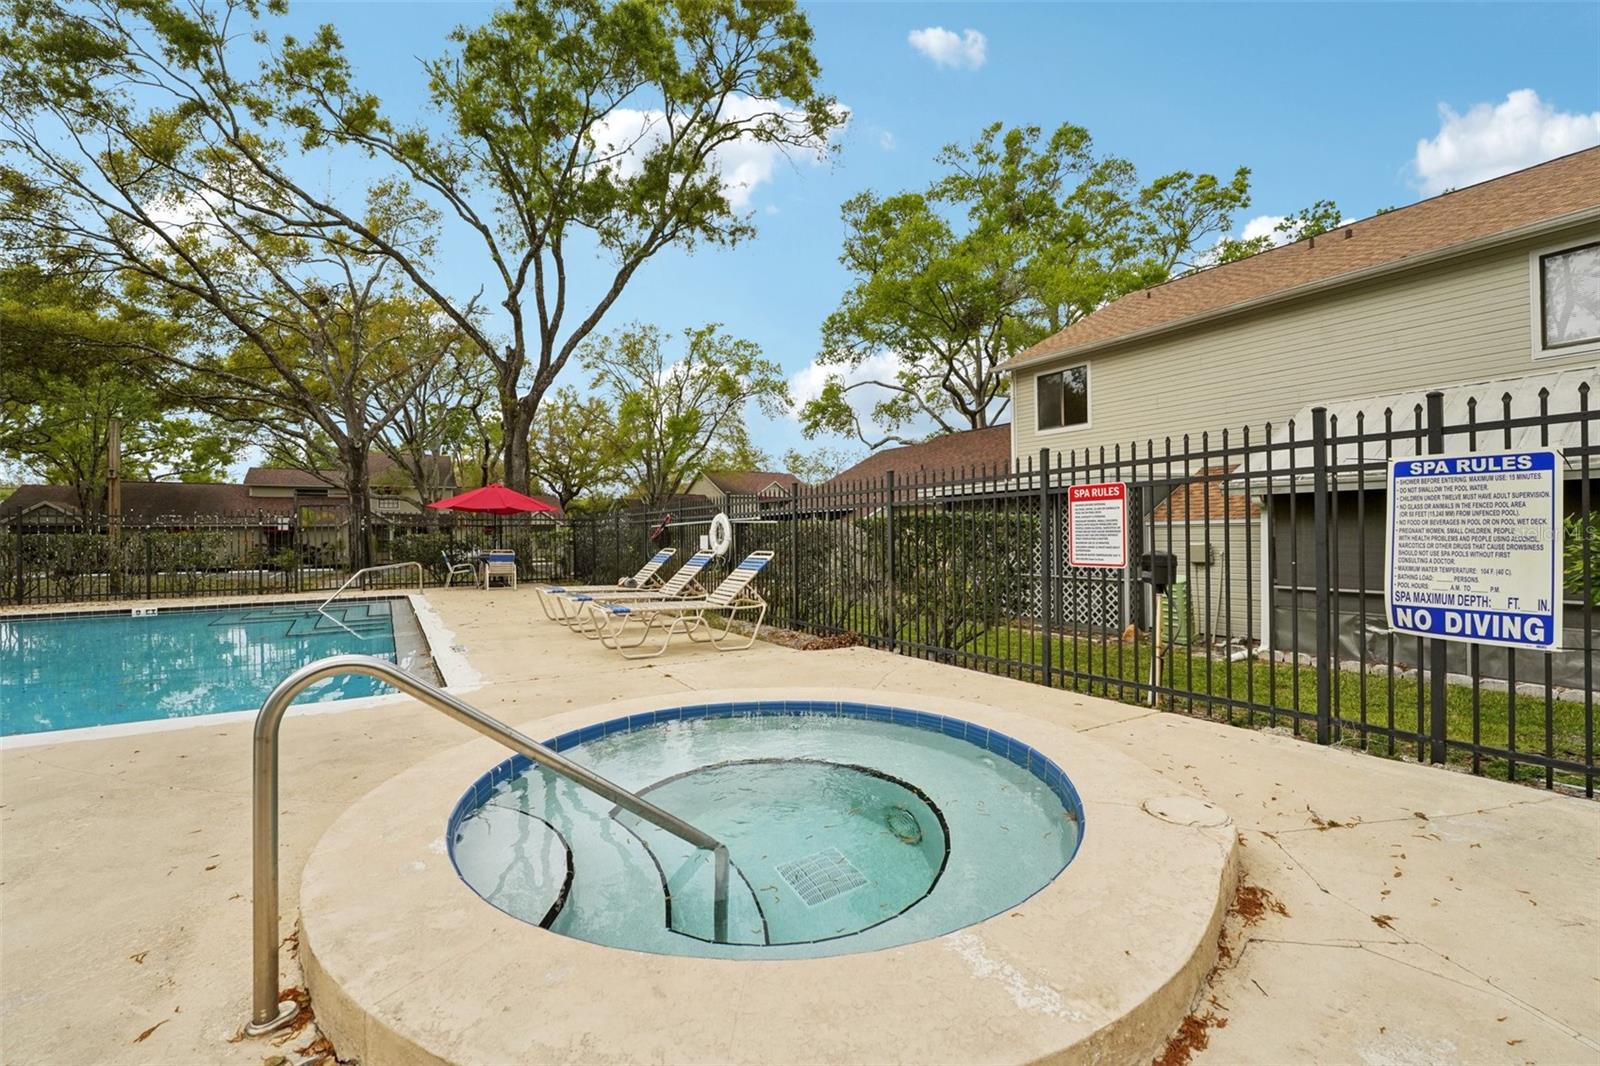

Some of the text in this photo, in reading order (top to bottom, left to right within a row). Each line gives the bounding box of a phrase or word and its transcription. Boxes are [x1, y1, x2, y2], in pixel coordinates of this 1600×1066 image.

[1410, 456, 1532, 475] SPA RULES
[1074, 486, 1120, 498] SPA RULES
[1395, 591, 1550, 612] SPA MAXIMUM DEPTH: FT. IN.
[1396, 607, 1544, 642] NO DIVING
